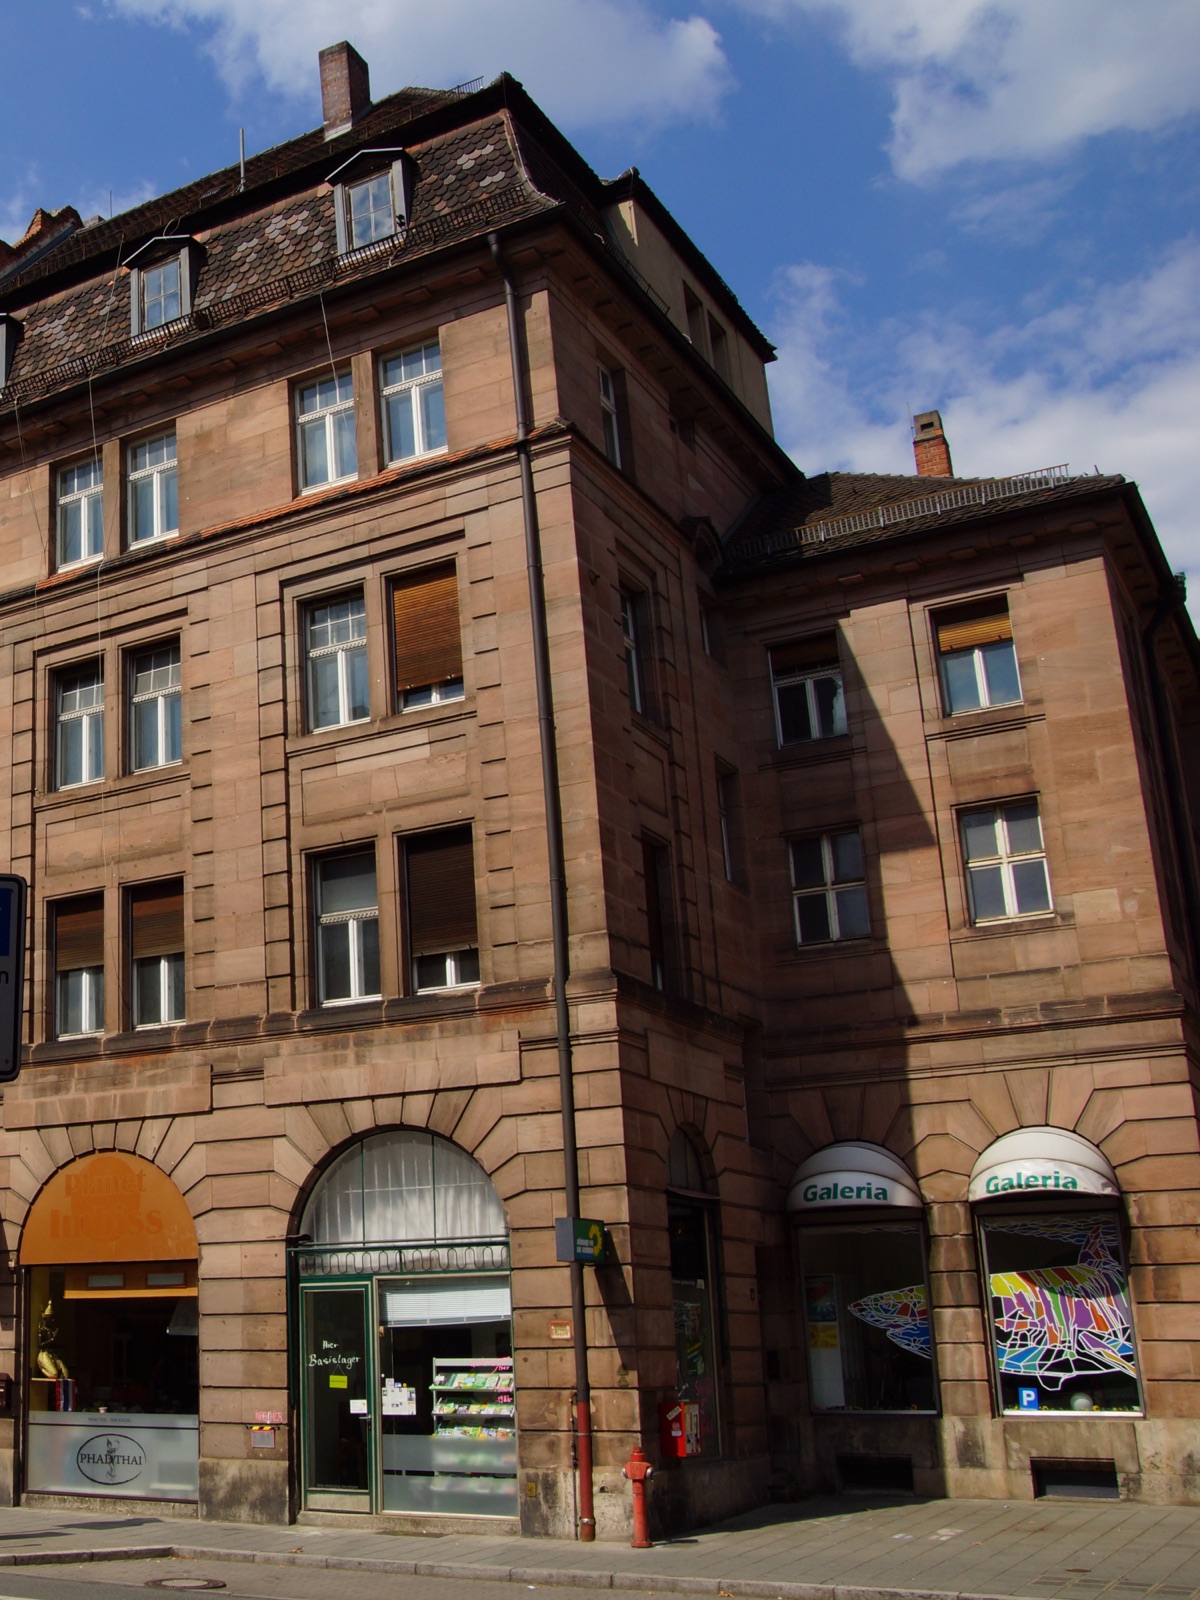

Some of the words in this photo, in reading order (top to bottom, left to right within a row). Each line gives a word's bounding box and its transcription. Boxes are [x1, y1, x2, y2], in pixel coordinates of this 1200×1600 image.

[985, 1171, 1078, 1194] Galeria
[803, 1182, 888, 1202] Galeria
[308, 1354, 361, 1369] Basislager
[1022, 1390, 1035, 1406] P
[115, 1455, 142, 1465] THAI
